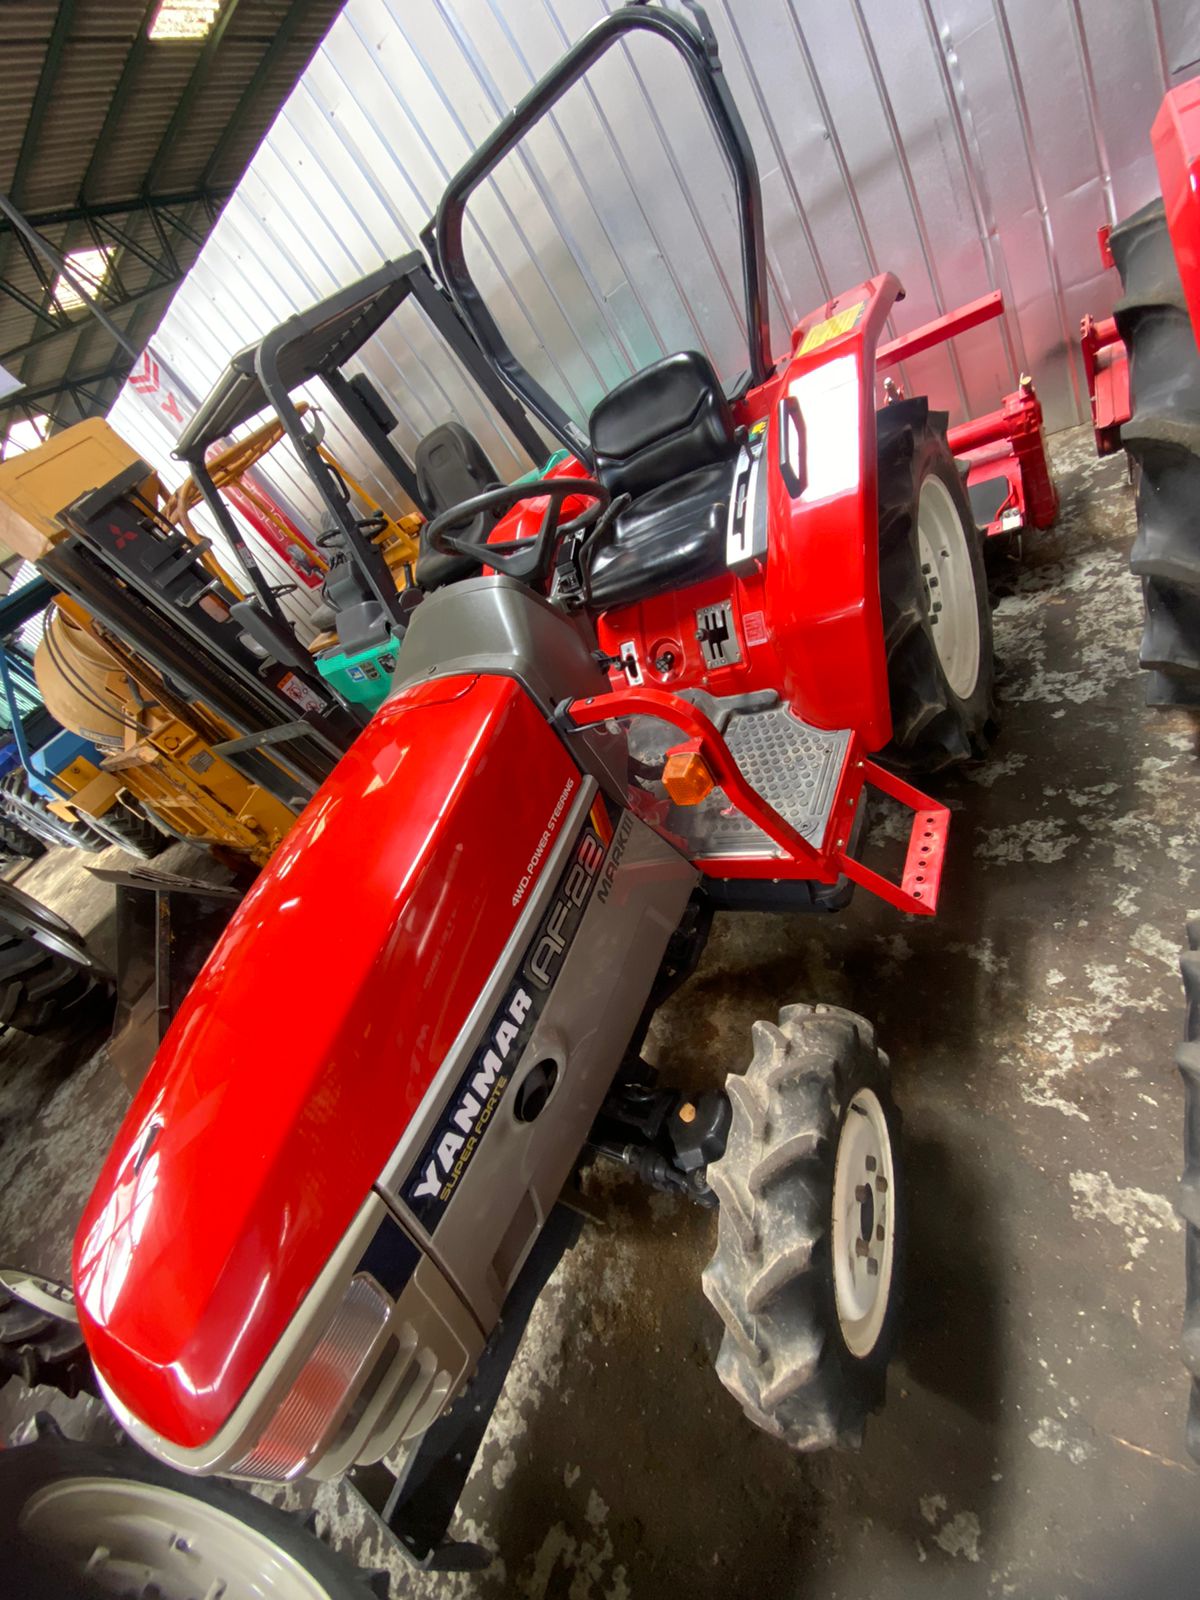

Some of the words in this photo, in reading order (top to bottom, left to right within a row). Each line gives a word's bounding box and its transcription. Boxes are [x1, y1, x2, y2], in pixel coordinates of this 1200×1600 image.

[526, 829, 552, 875] POWER
[547, 777, 575, 831] STEERING
[413, 987, 533, 1198] YANMAR
[440, 1136, 478, 1202] SUPER
[474, 1075, 508, 1135] FORTE
